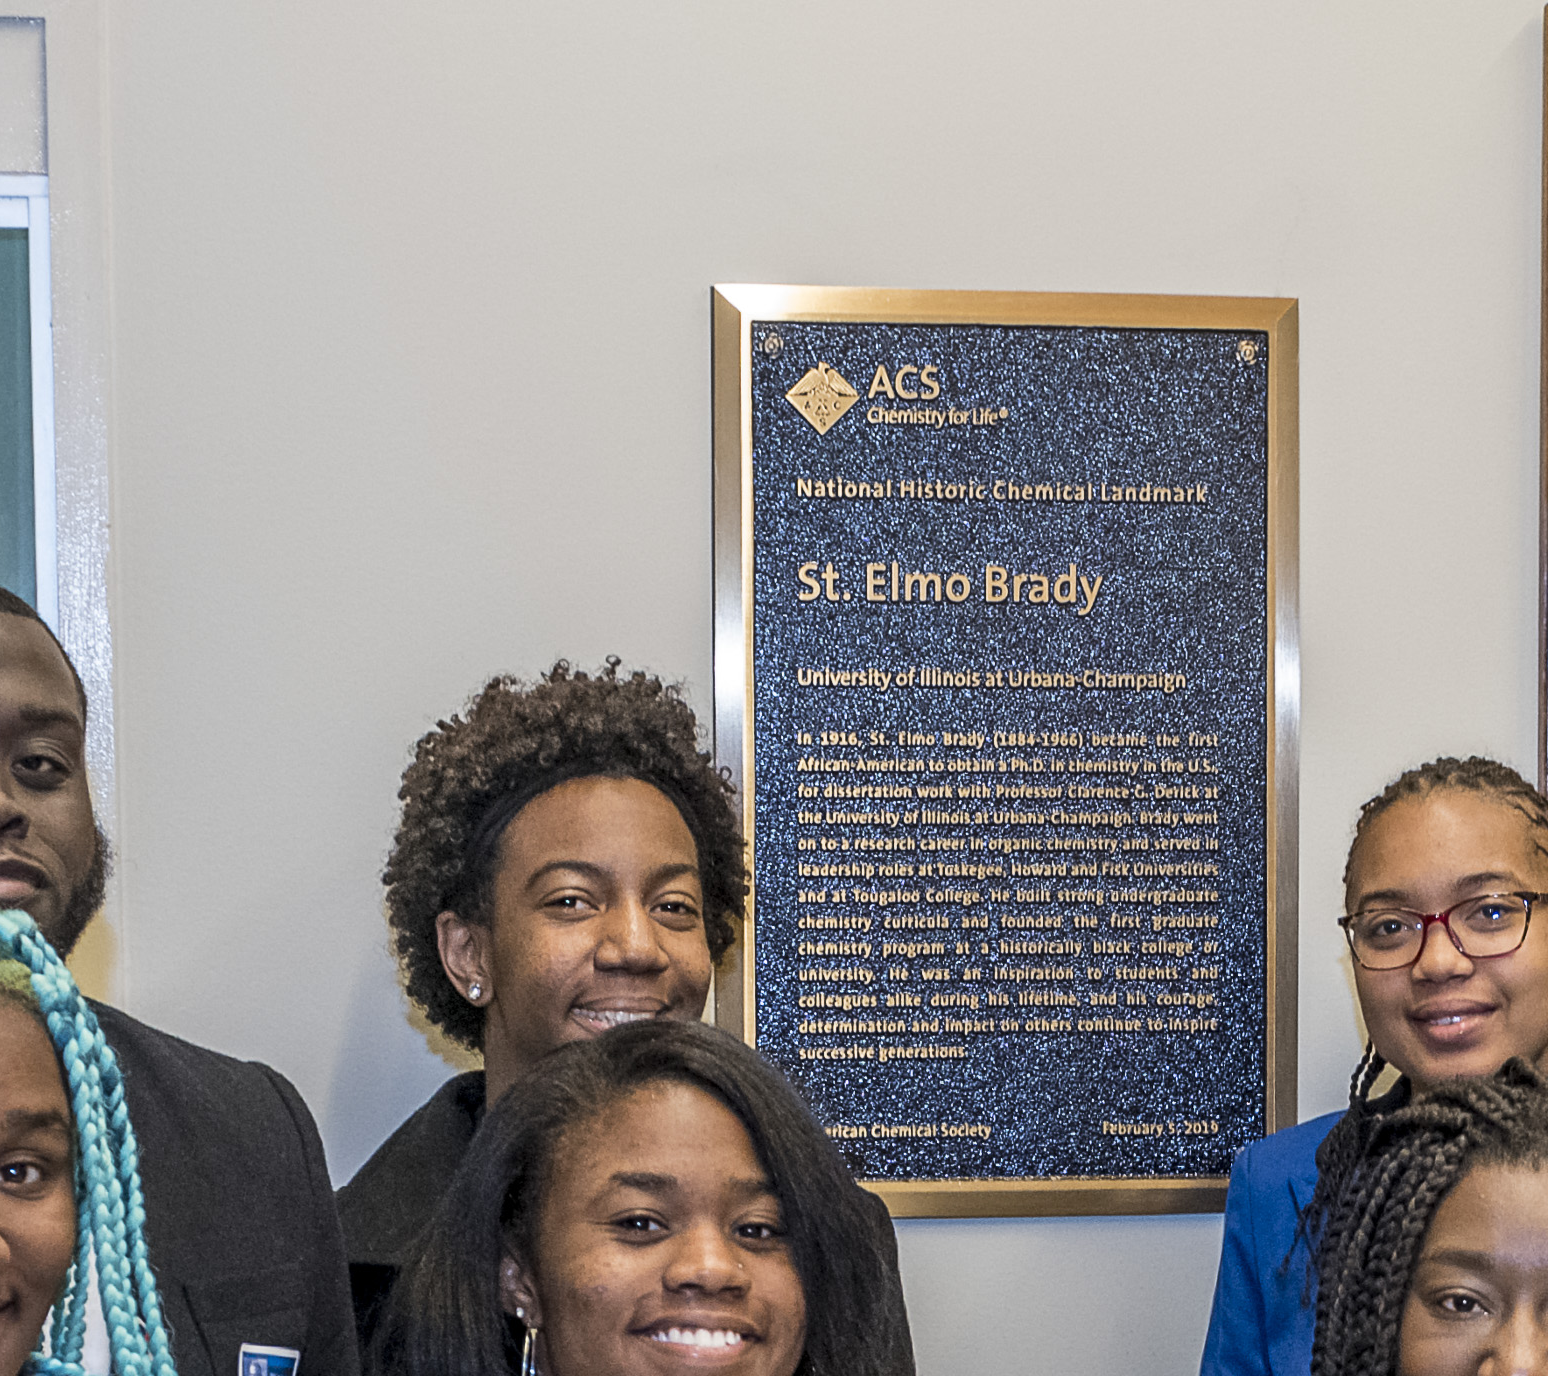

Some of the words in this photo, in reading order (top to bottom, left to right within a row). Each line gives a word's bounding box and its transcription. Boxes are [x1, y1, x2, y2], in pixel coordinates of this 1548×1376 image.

[868, 365, 940, 400] ACS
[867, 407, 945, 429] Chemistry
[948, 408, 969, 425] for
[796, 478, 891, 500] National
[899, 479, 984, 501] Historic
[992, 480, 1092, 502] Chemical
[1100, 481, 1208, 503] Landmark
[797, 562, 849, 602] St.
[865, 562, 970, 603] Elmo
[984, 563, 1104, 614] Brady
[797, 667, 891, 693] University
[895, 667, 914, 688] of
[920, 667, 980, 688] Illinois
[985, 668, 1003, 688] at
[1008, 668, 1187, 694] Urbana-Champaign
[797, 732, 813, 747] In
[820, 732, 862, 749] 1916,
[869, 732, 889, 747] St.
[897, 732, 935, 747] Elmo
[942, 732, 985, 751] Brady
[992, 732, 1083, 751] (1884-1966)
[1091, 732, 1148, 747] became
[1155, 732, 1180, 747] the
[1188, 732, 1219, 747] first
[799, 1045, 873, 1060] successive
[878, 1044, 967, 1063] generations.
[870, 1122, 936, 1138] Chemical
[940, 1122, 992, 1142] Society
[1101, 1120, 1163, 1139] February
[1184, 1120, 1219, 1135] 2019
